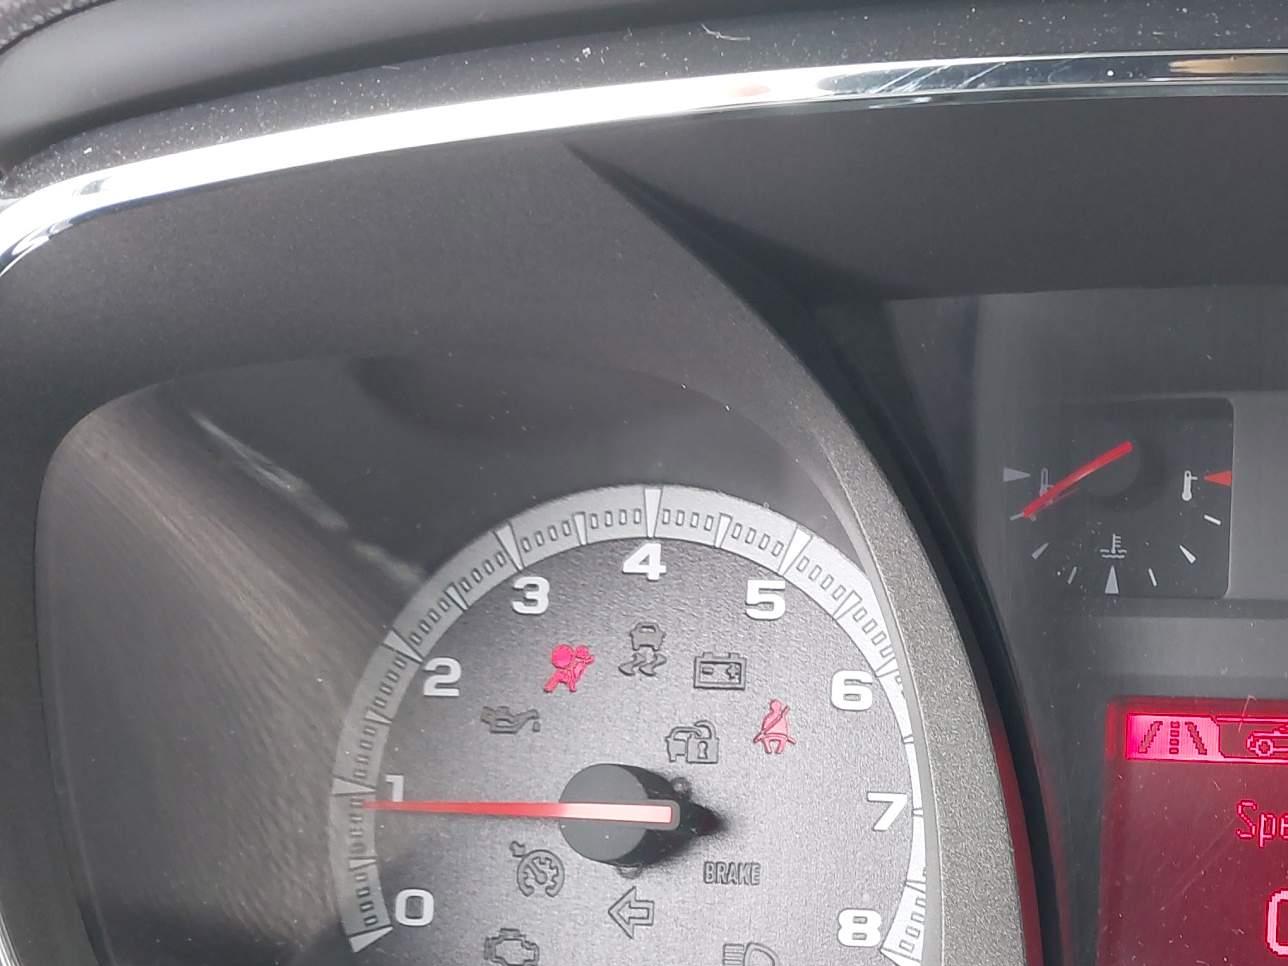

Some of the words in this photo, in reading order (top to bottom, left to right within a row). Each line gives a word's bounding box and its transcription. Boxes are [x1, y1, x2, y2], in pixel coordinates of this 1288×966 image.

[622, 543, 666, 580] 4
[511, 577, 550, 614] 3
[745, 579, 786, 619] 5
[423, 657, 460, 697] 2
[831, 670, 873, 711] 6
[385, 774, 404, 802] 1
[867, 792, 908, 831] 7
[703, 862, 761, 886] BRAKE
[394, 889, 434, 926] 0
[837, 908, 882, 947] 8
